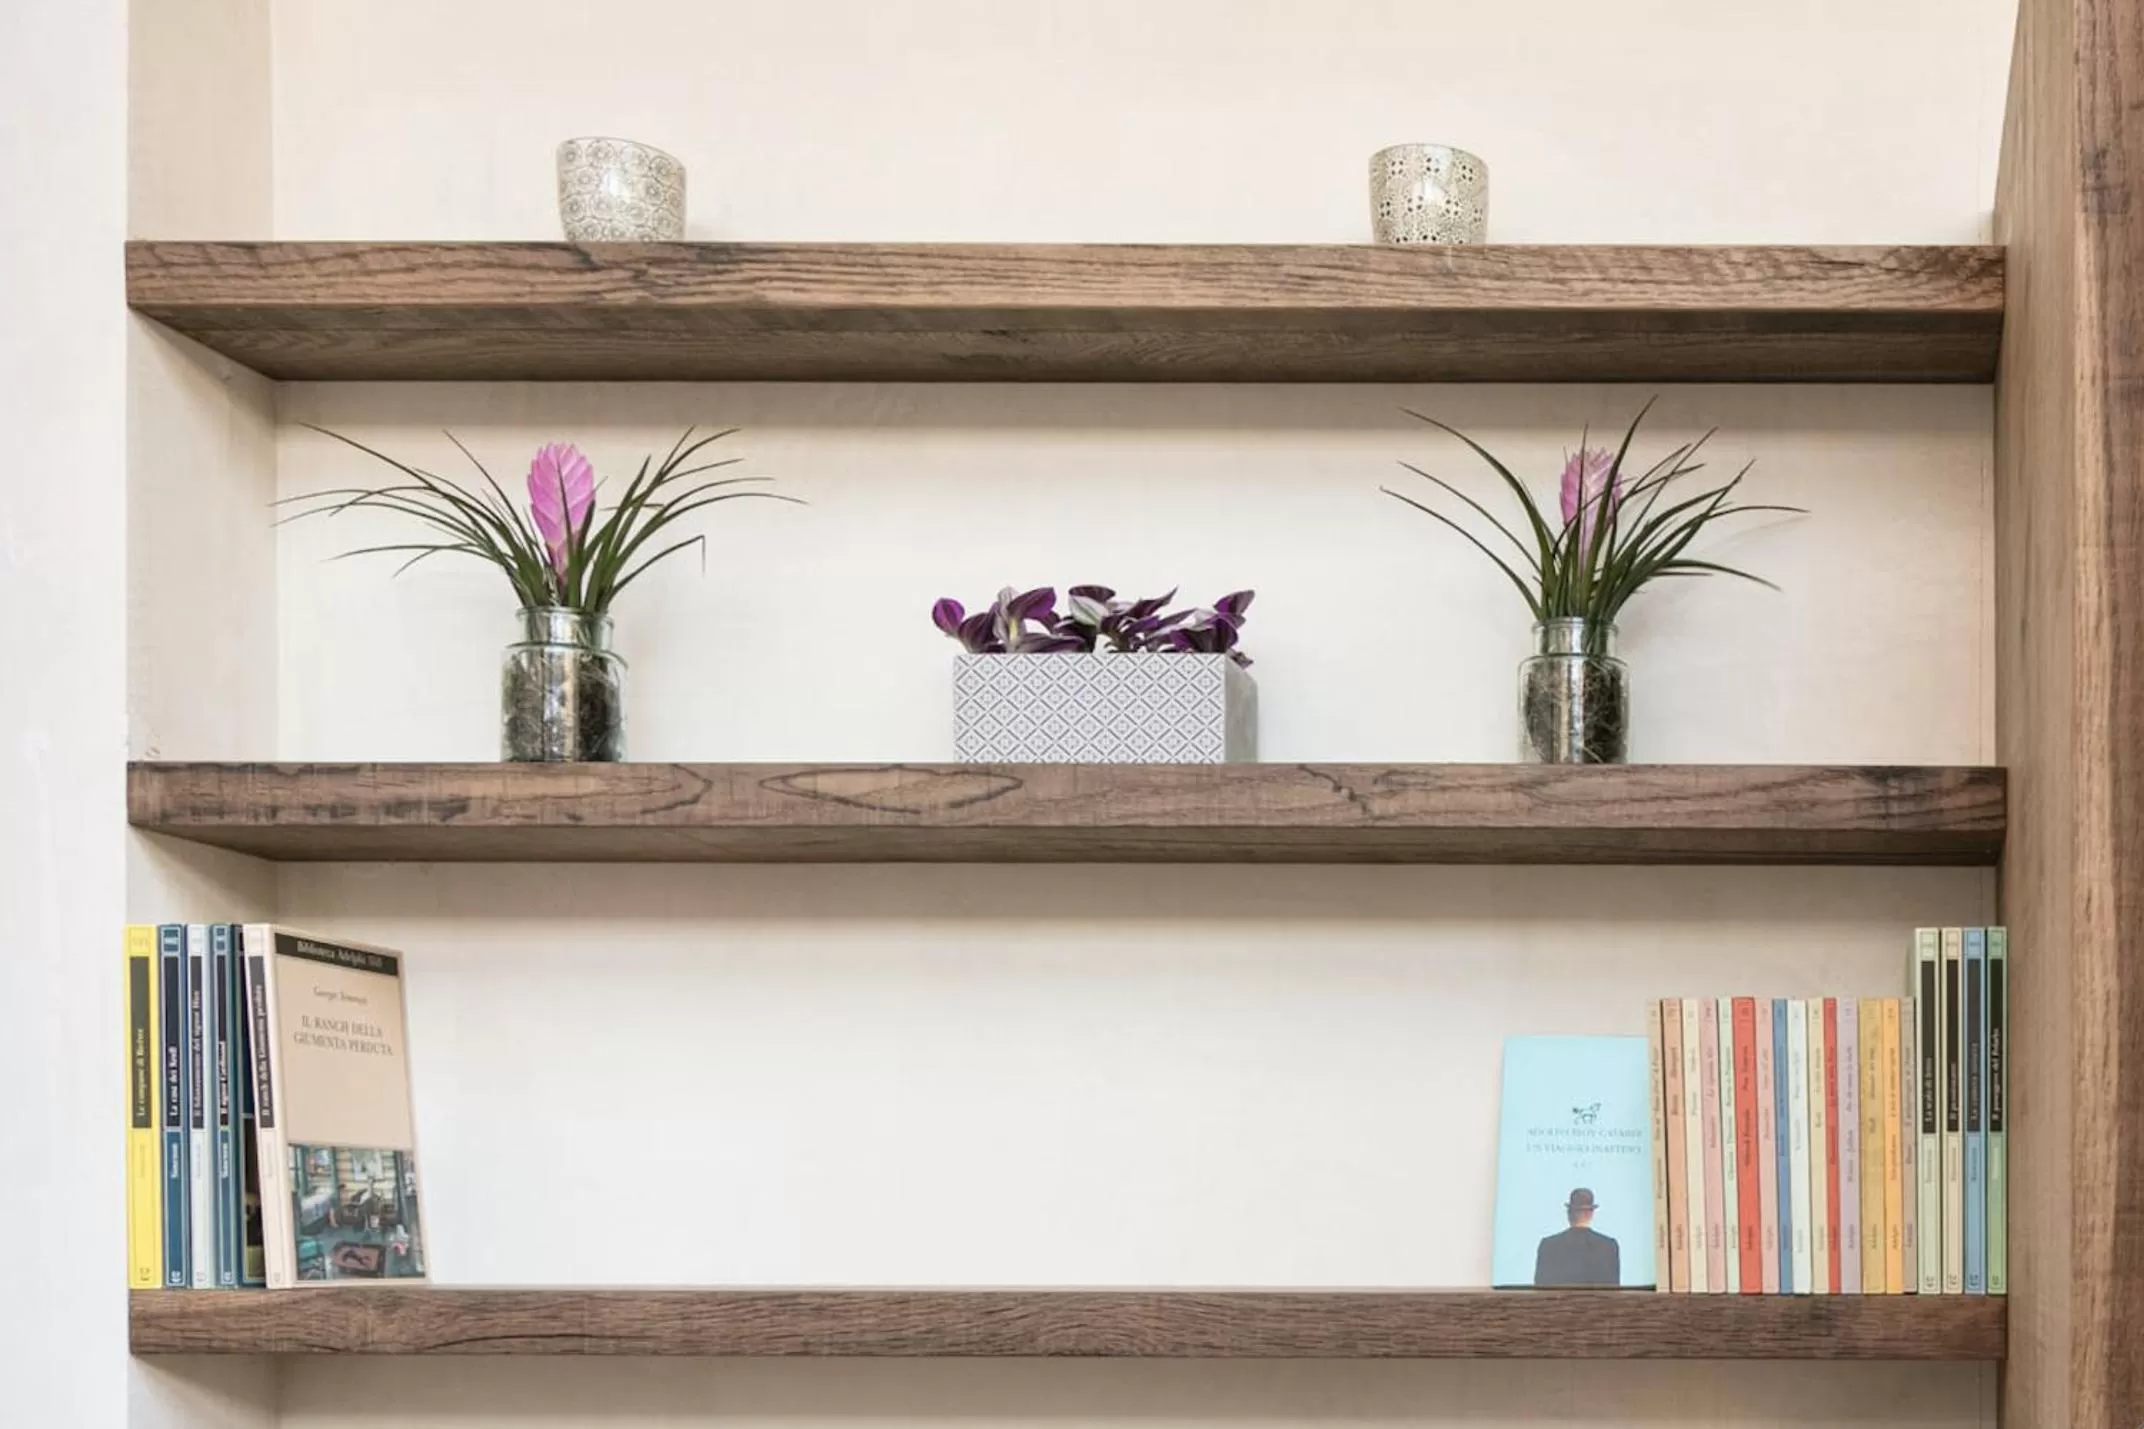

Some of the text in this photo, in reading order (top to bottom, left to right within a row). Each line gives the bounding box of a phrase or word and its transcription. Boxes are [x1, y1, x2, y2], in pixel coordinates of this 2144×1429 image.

[302, 1015, 383, 1037] IL RANCH DELLA
[293, 1032, 393, 1056] GIUMENTA PERDUTA
[170, 1104, 178, 1116] La
